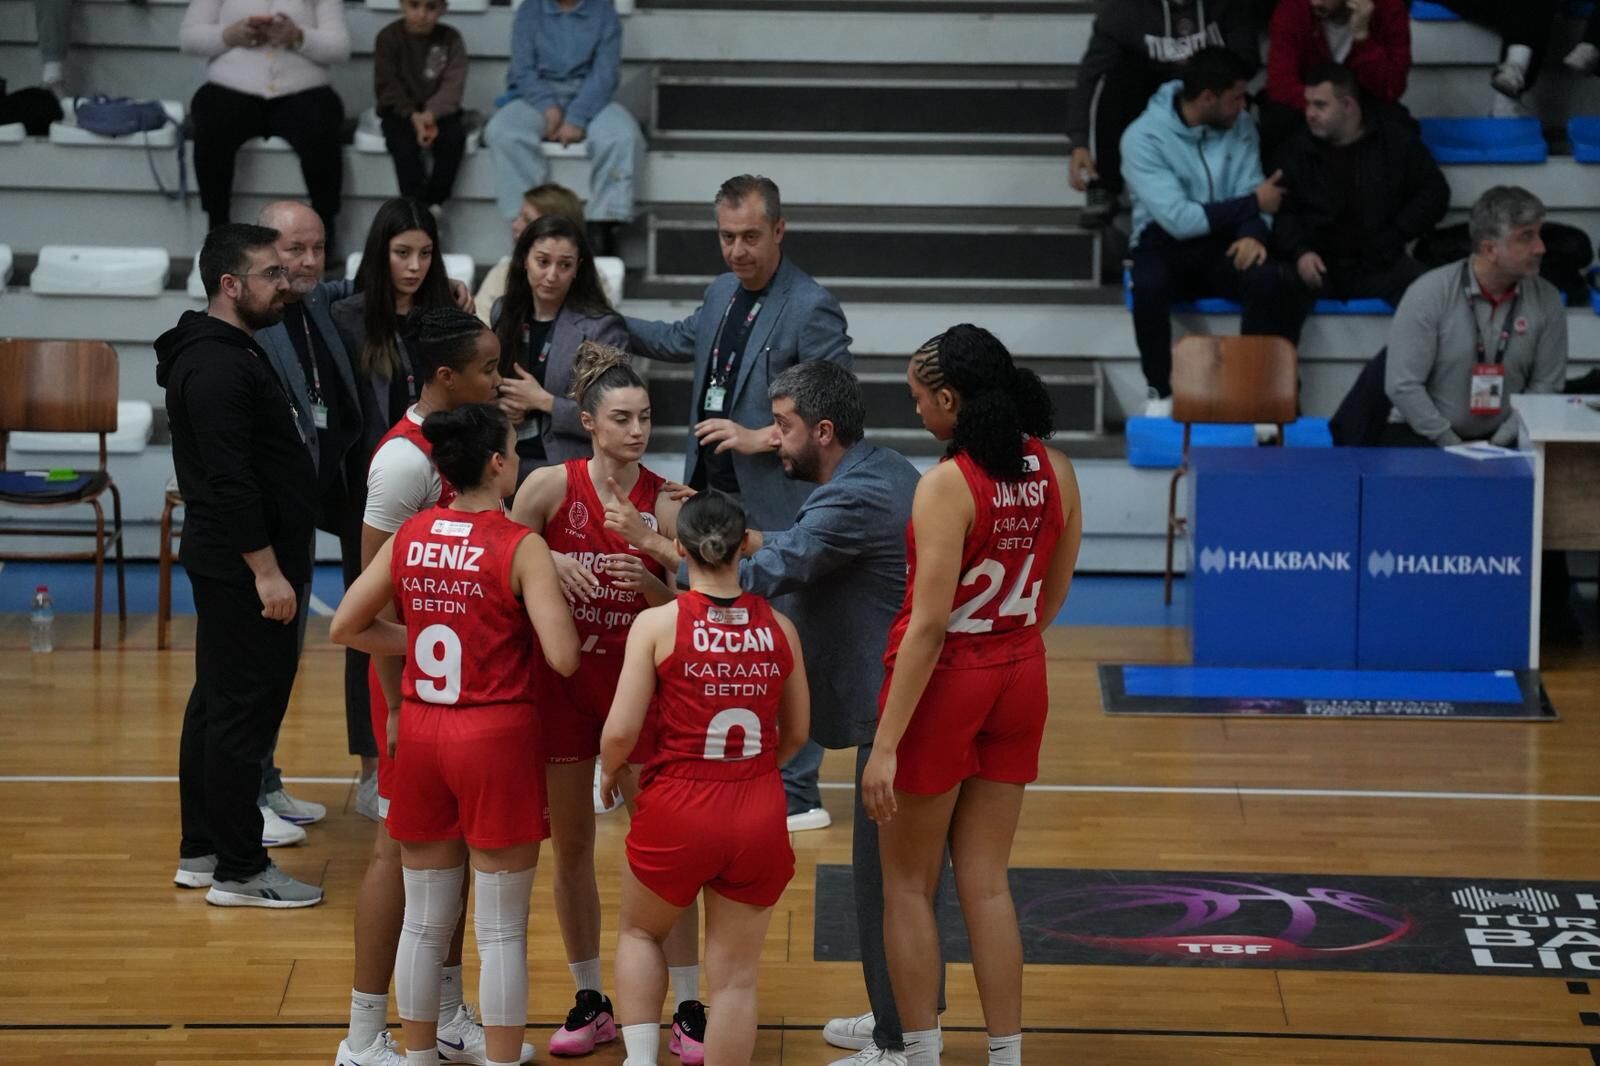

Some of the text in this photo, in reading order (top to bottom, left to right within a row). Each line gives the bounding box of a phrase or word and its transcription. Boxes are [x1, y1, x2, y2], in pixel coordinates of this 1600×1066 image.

[997, 537, 1033, 550] BETO
[406, 539, 485, 572] DENİZ
[1228, 551, 1350, 571] HALKBANK
[1397, 555, 1522, 575] HALKBANK
[402, 577, 484, 598] KARAATA
[946, 554, 1043, 634] 24
[412, 598, 466, 614] BETON
[693, 620, 774, 653] ÖZCAN
[415, 624, 462, 705] 9
[684, 662, 781, 678] KARAATA
[704, 684, 768, 696] BETON
[1177, 943, 1273, 954] TBF
